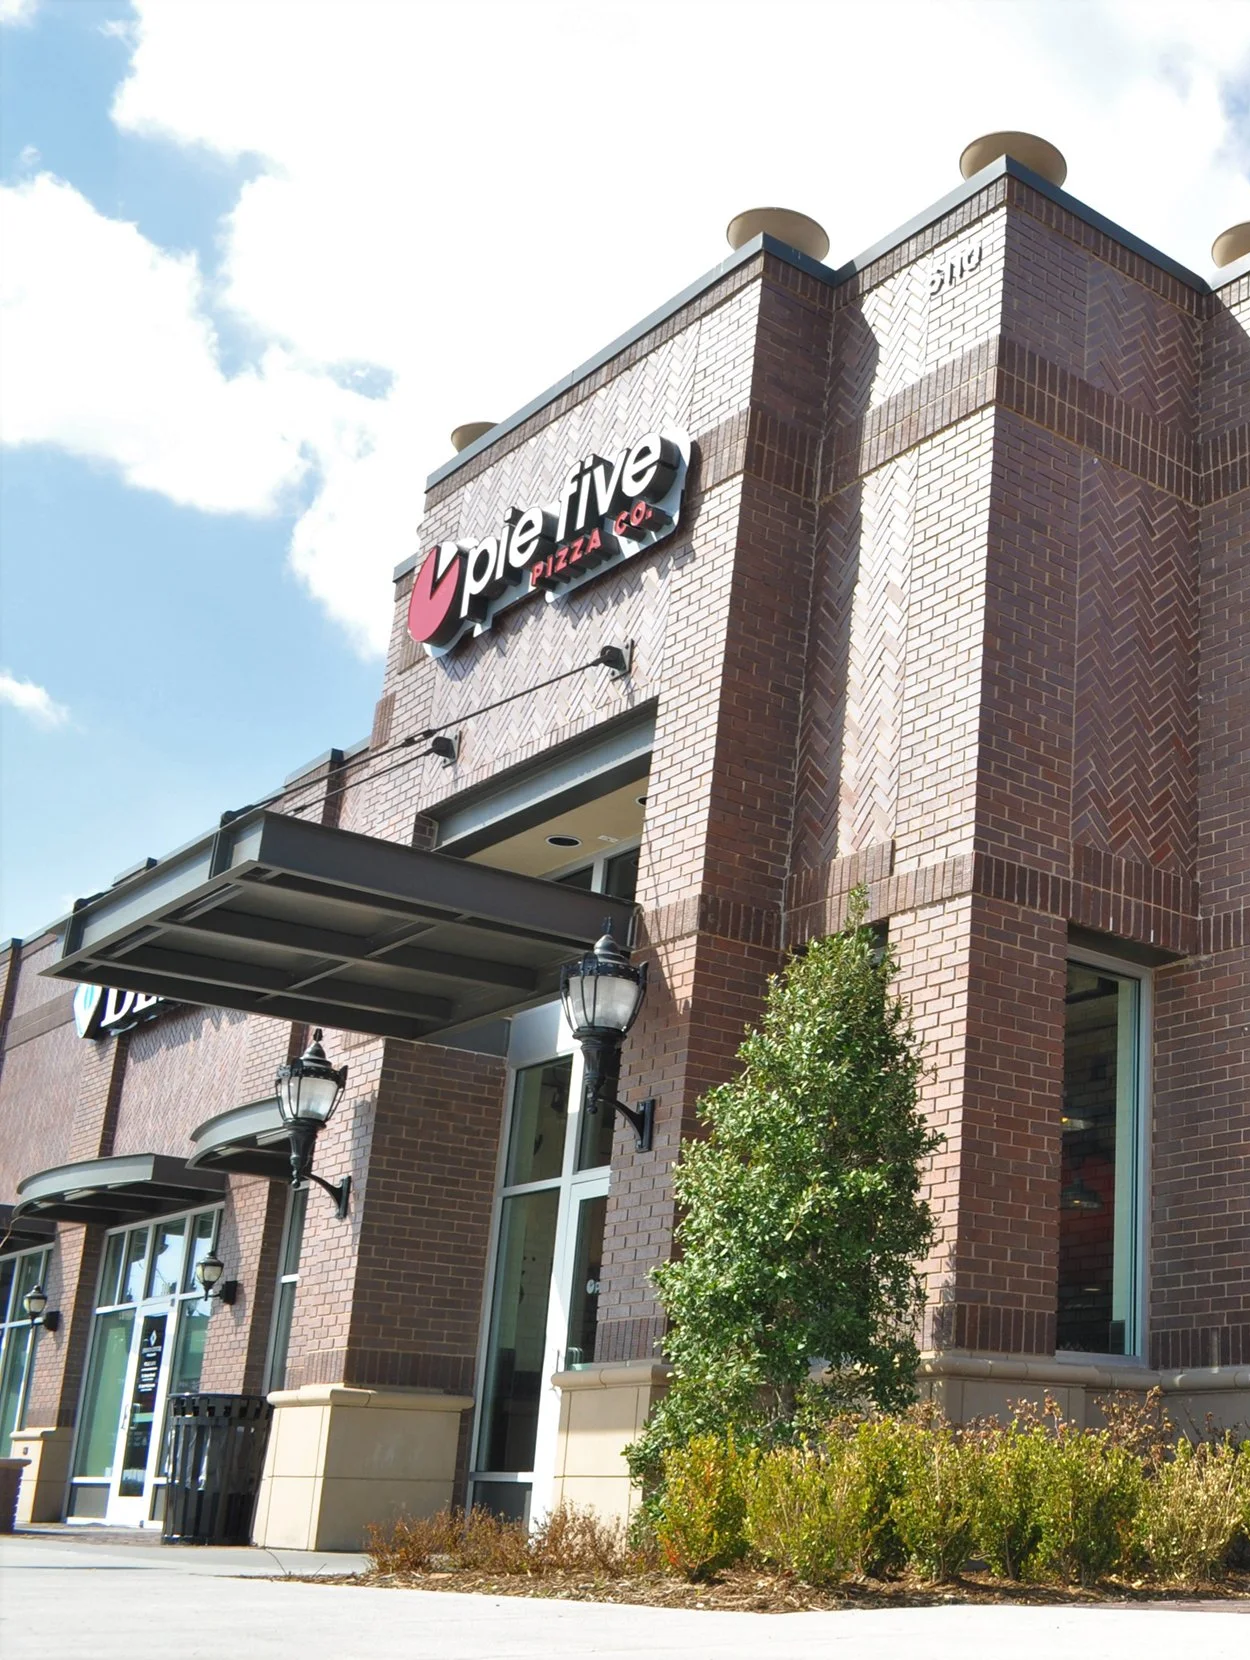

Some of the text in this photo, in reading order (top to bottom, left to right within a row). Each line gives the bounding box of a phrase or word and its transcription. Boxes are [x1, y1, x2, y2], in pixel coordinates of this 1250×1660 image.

[459, 431, 662, 619] pie five
[530, 527, 602, 586] PIZZA
